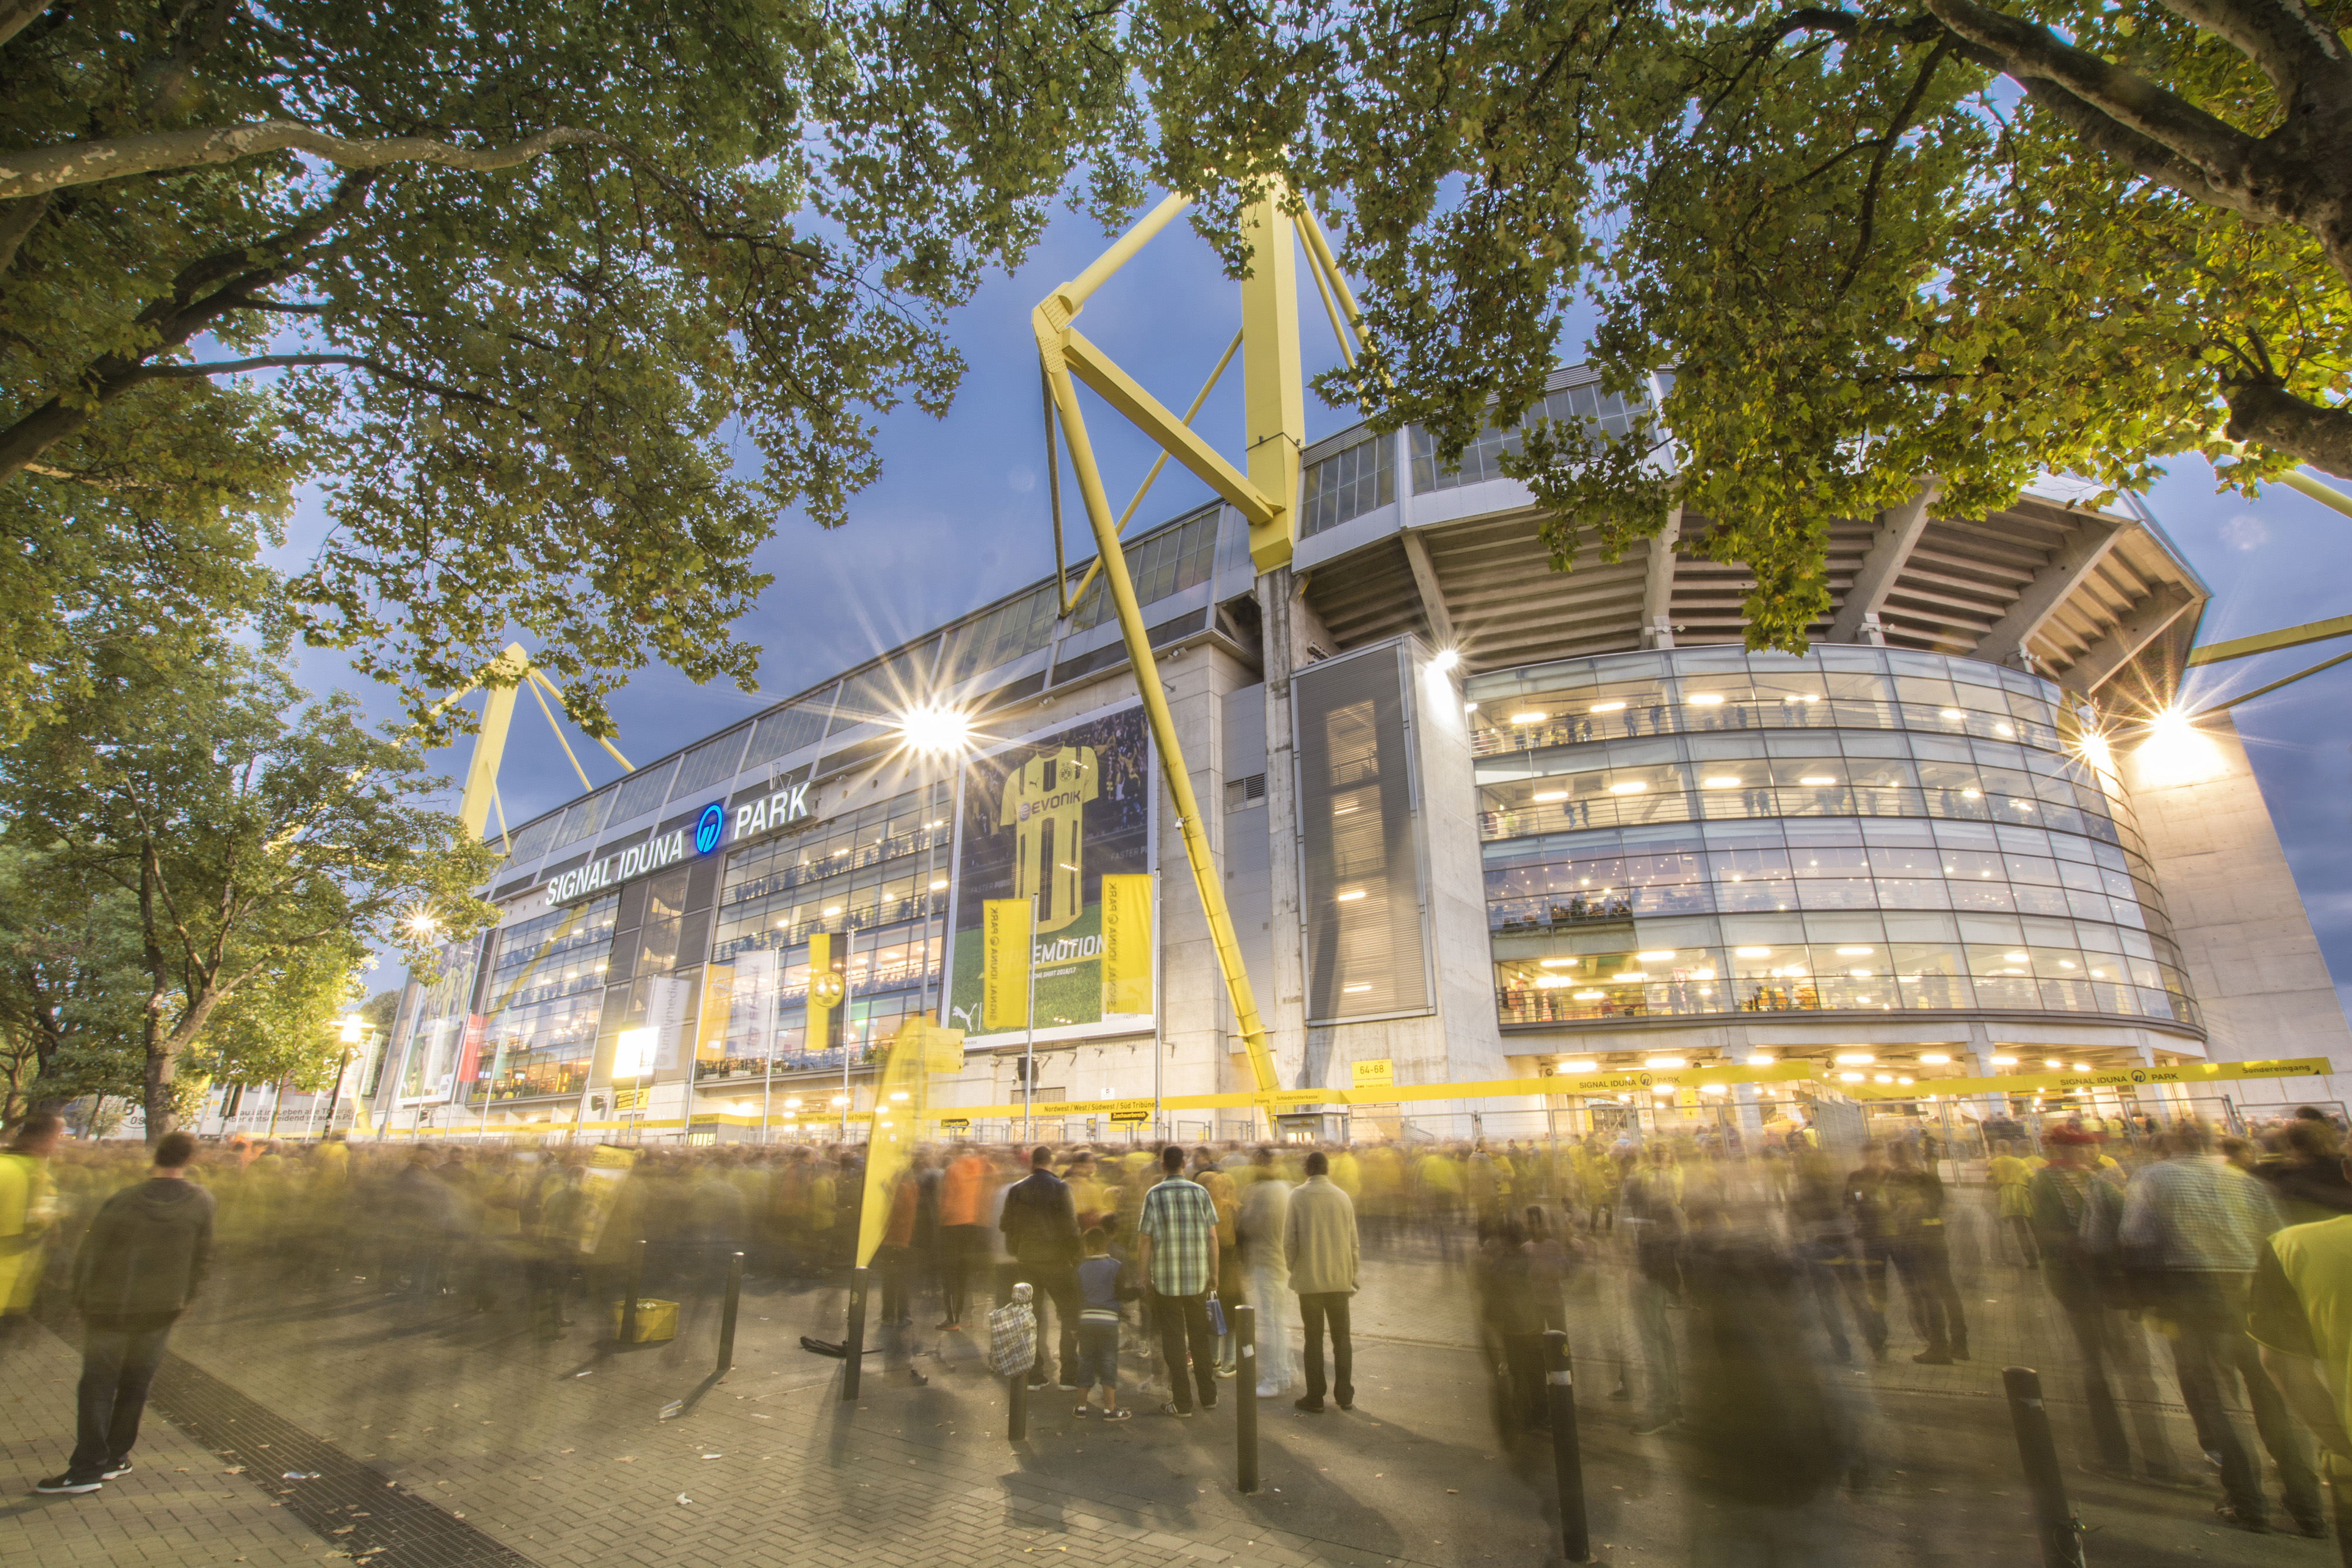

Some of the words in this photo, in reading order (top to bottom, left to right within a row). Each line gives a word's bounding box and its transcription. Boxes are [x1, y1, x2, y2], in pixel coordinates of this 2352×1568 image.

[1032, 790, 1081, 815] EVONIK
[545, 857, 612, 906] SIGNAL
[617, 830, 683, 881] IDUNA
[734, 781, 811, 840] PARK
[1111, 847, 1139, 861] FASTER
[1034, 933, 1108, 965] EMOTION
[1057, 967, 1077, 976] 2016/17
[1360, 1065, 1384, 1074] 64-68
[2241, 1064, 2311, 1074] Sondereingang
[2060, 1077, 2095, 1085] SIGNAL
[2096, 1075, 2127, 1084] IDUNA
[2151, 1073, 2179, 1081] PARK
[1579, 1081, 1611, 1089] SIGNAL
[1044, 1104, 1069, 1112] Nordwest
[1091, 1102, 1115, 1111] Südwest
[1120, 1101, 1131, 1109] Süd
[1132, 1101, 1160, 1109] Tribüne
[131, 1116, 145, 1125] 09
